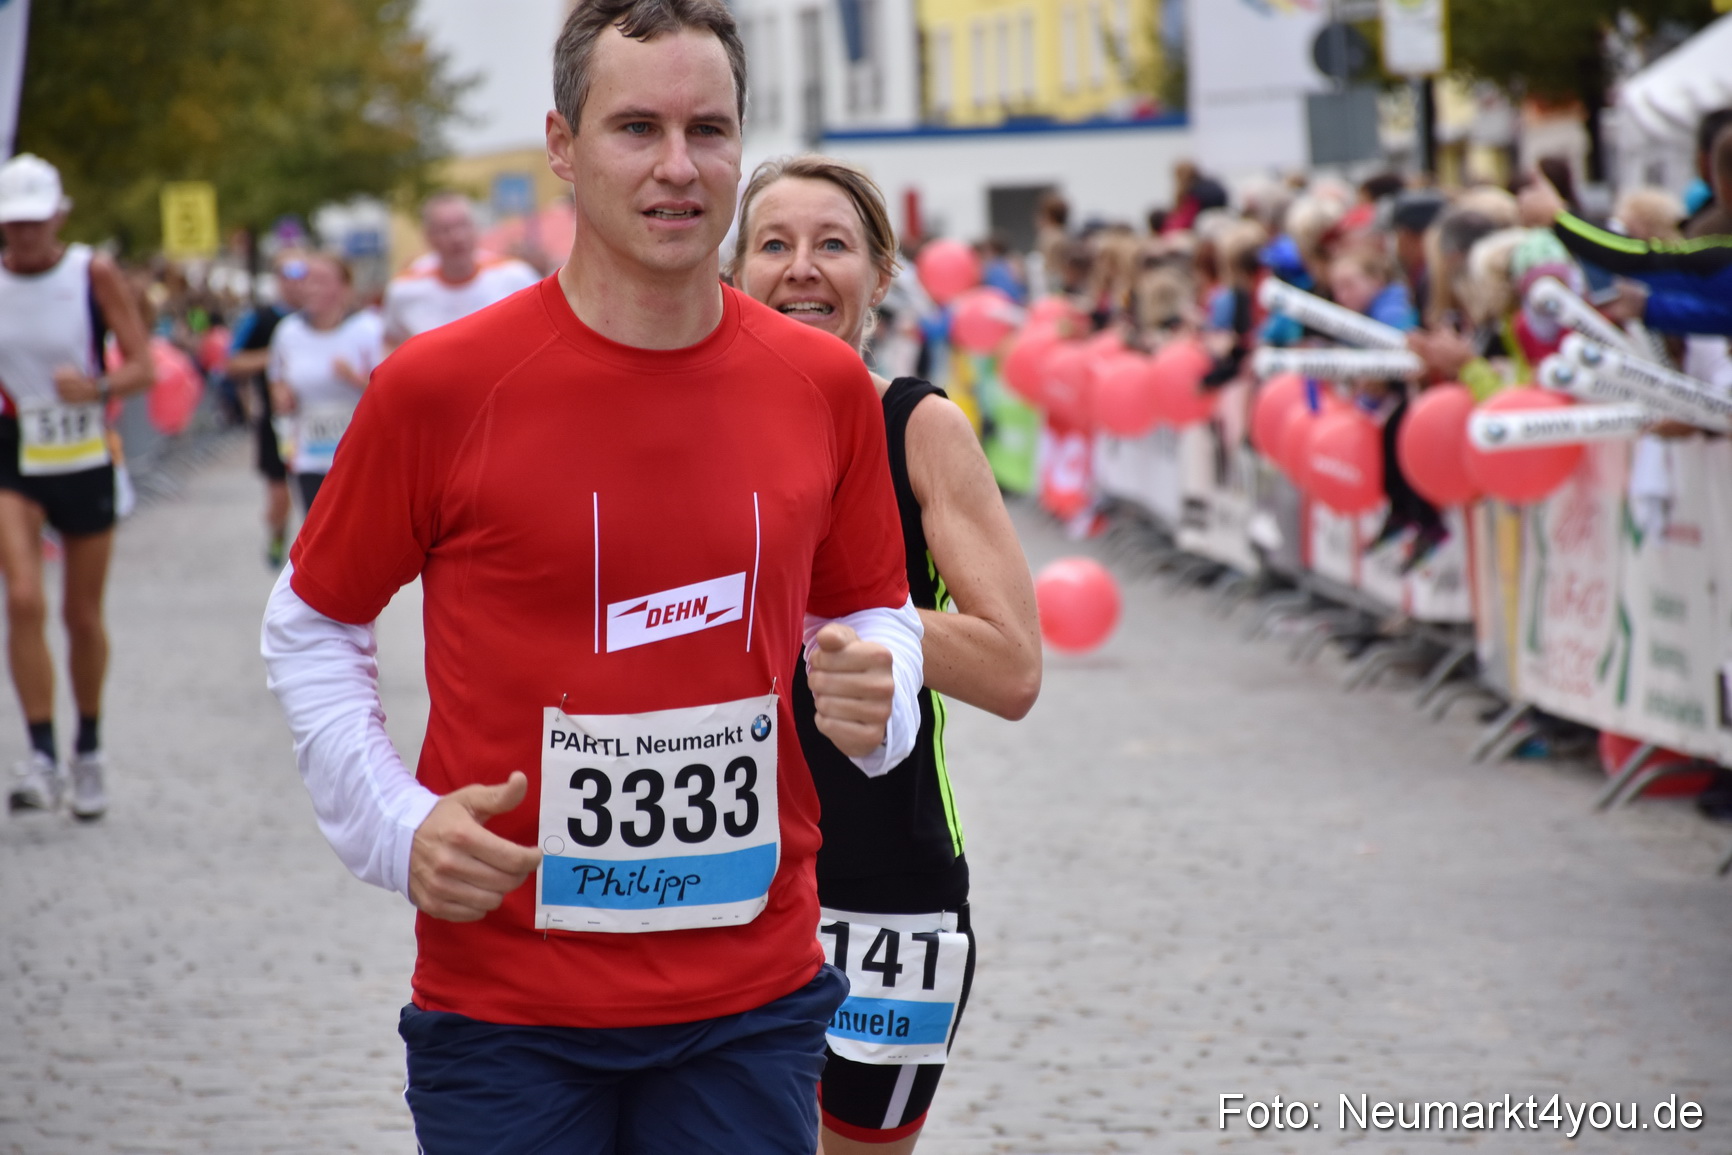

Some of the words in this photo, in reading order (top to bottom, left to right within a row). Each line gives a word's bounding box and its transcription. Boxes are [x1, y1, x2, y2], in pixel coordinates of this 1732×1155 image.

[645, 595, 709, 629] DEHN
[550, 729, 630, 758] PARTL
[636, 725, 743, 756] Neumarkt
[567, 755, 759, 848] 3333
[571, 864, 701, 906] Philipp
